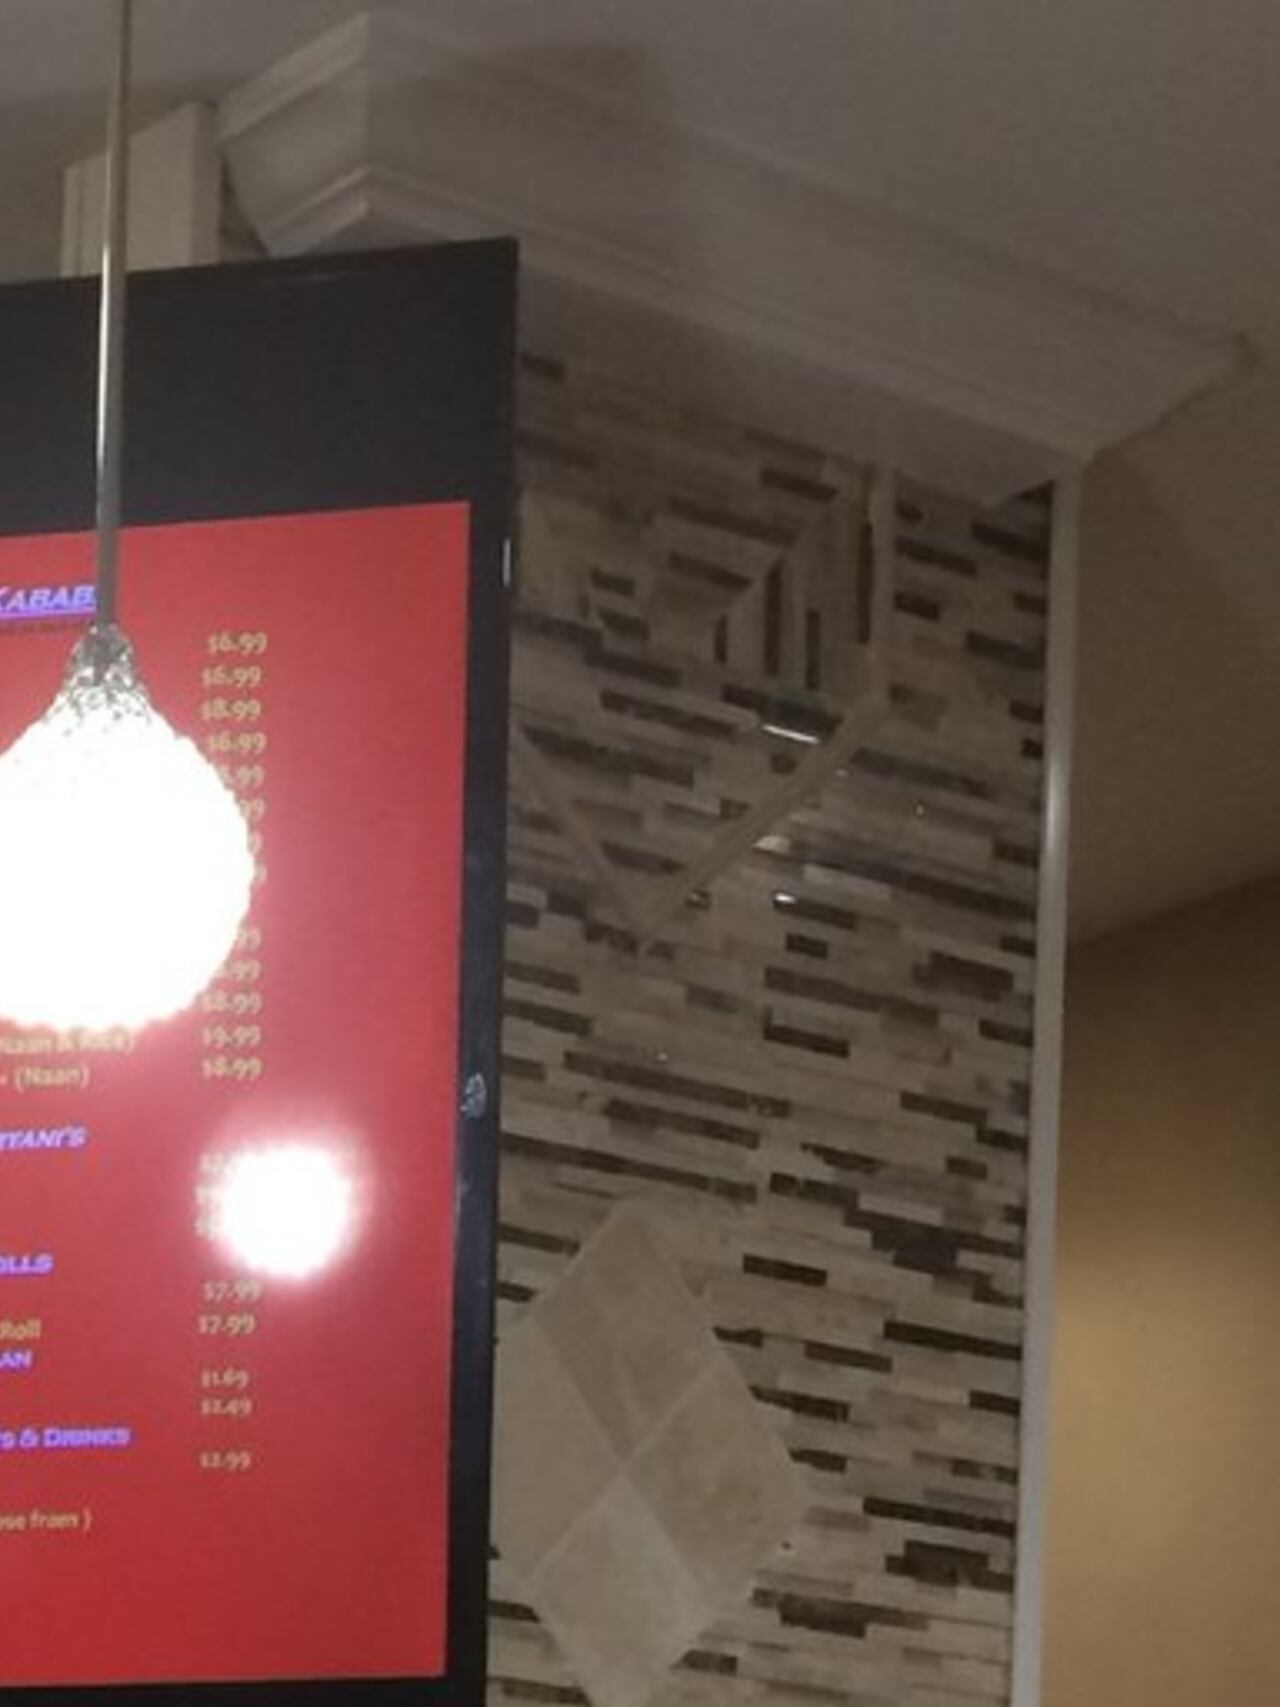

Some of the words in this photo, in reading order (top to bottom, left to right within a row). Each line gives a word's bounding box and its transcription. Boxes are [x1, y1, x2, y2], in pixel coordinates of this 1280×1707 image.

[208, 632, 268, 654] $6.99
[15, 1066, 91, 1094] (Naan)
[29, 1508, 79, 1528] from
